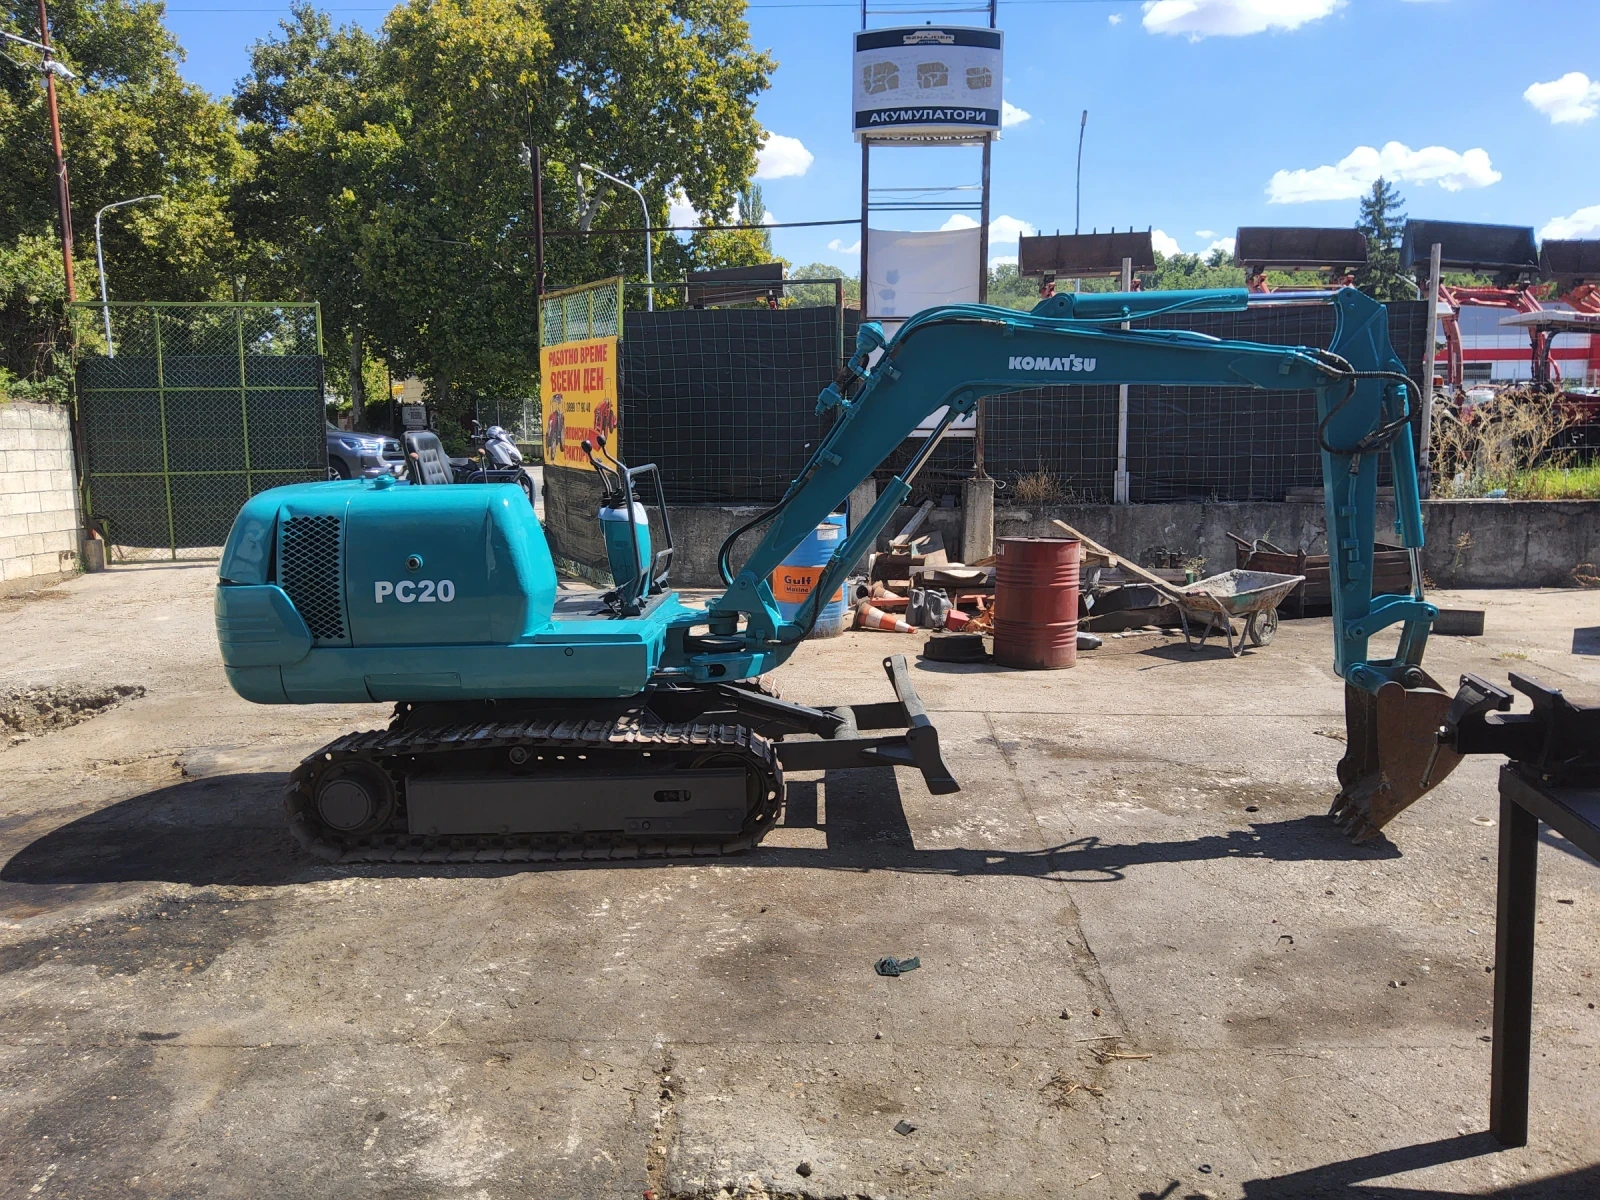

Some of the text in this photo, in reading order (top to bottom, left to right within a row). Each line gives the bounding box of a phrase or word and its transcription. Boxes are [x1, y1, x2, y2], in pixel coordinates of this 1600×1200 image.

[870, 109, 987, 123] АКУМУЛАТОРИ
[548, 343, 608, 368] РАБОТНО ВРЕМЕ
[1008, 354, 1097, 372] KOMATSU
[550, 367, 604, 394] ВСЕКИ ДЕН
[784, 575, 812, 585] Gulf
[374, 579, 456, 604] PC20
